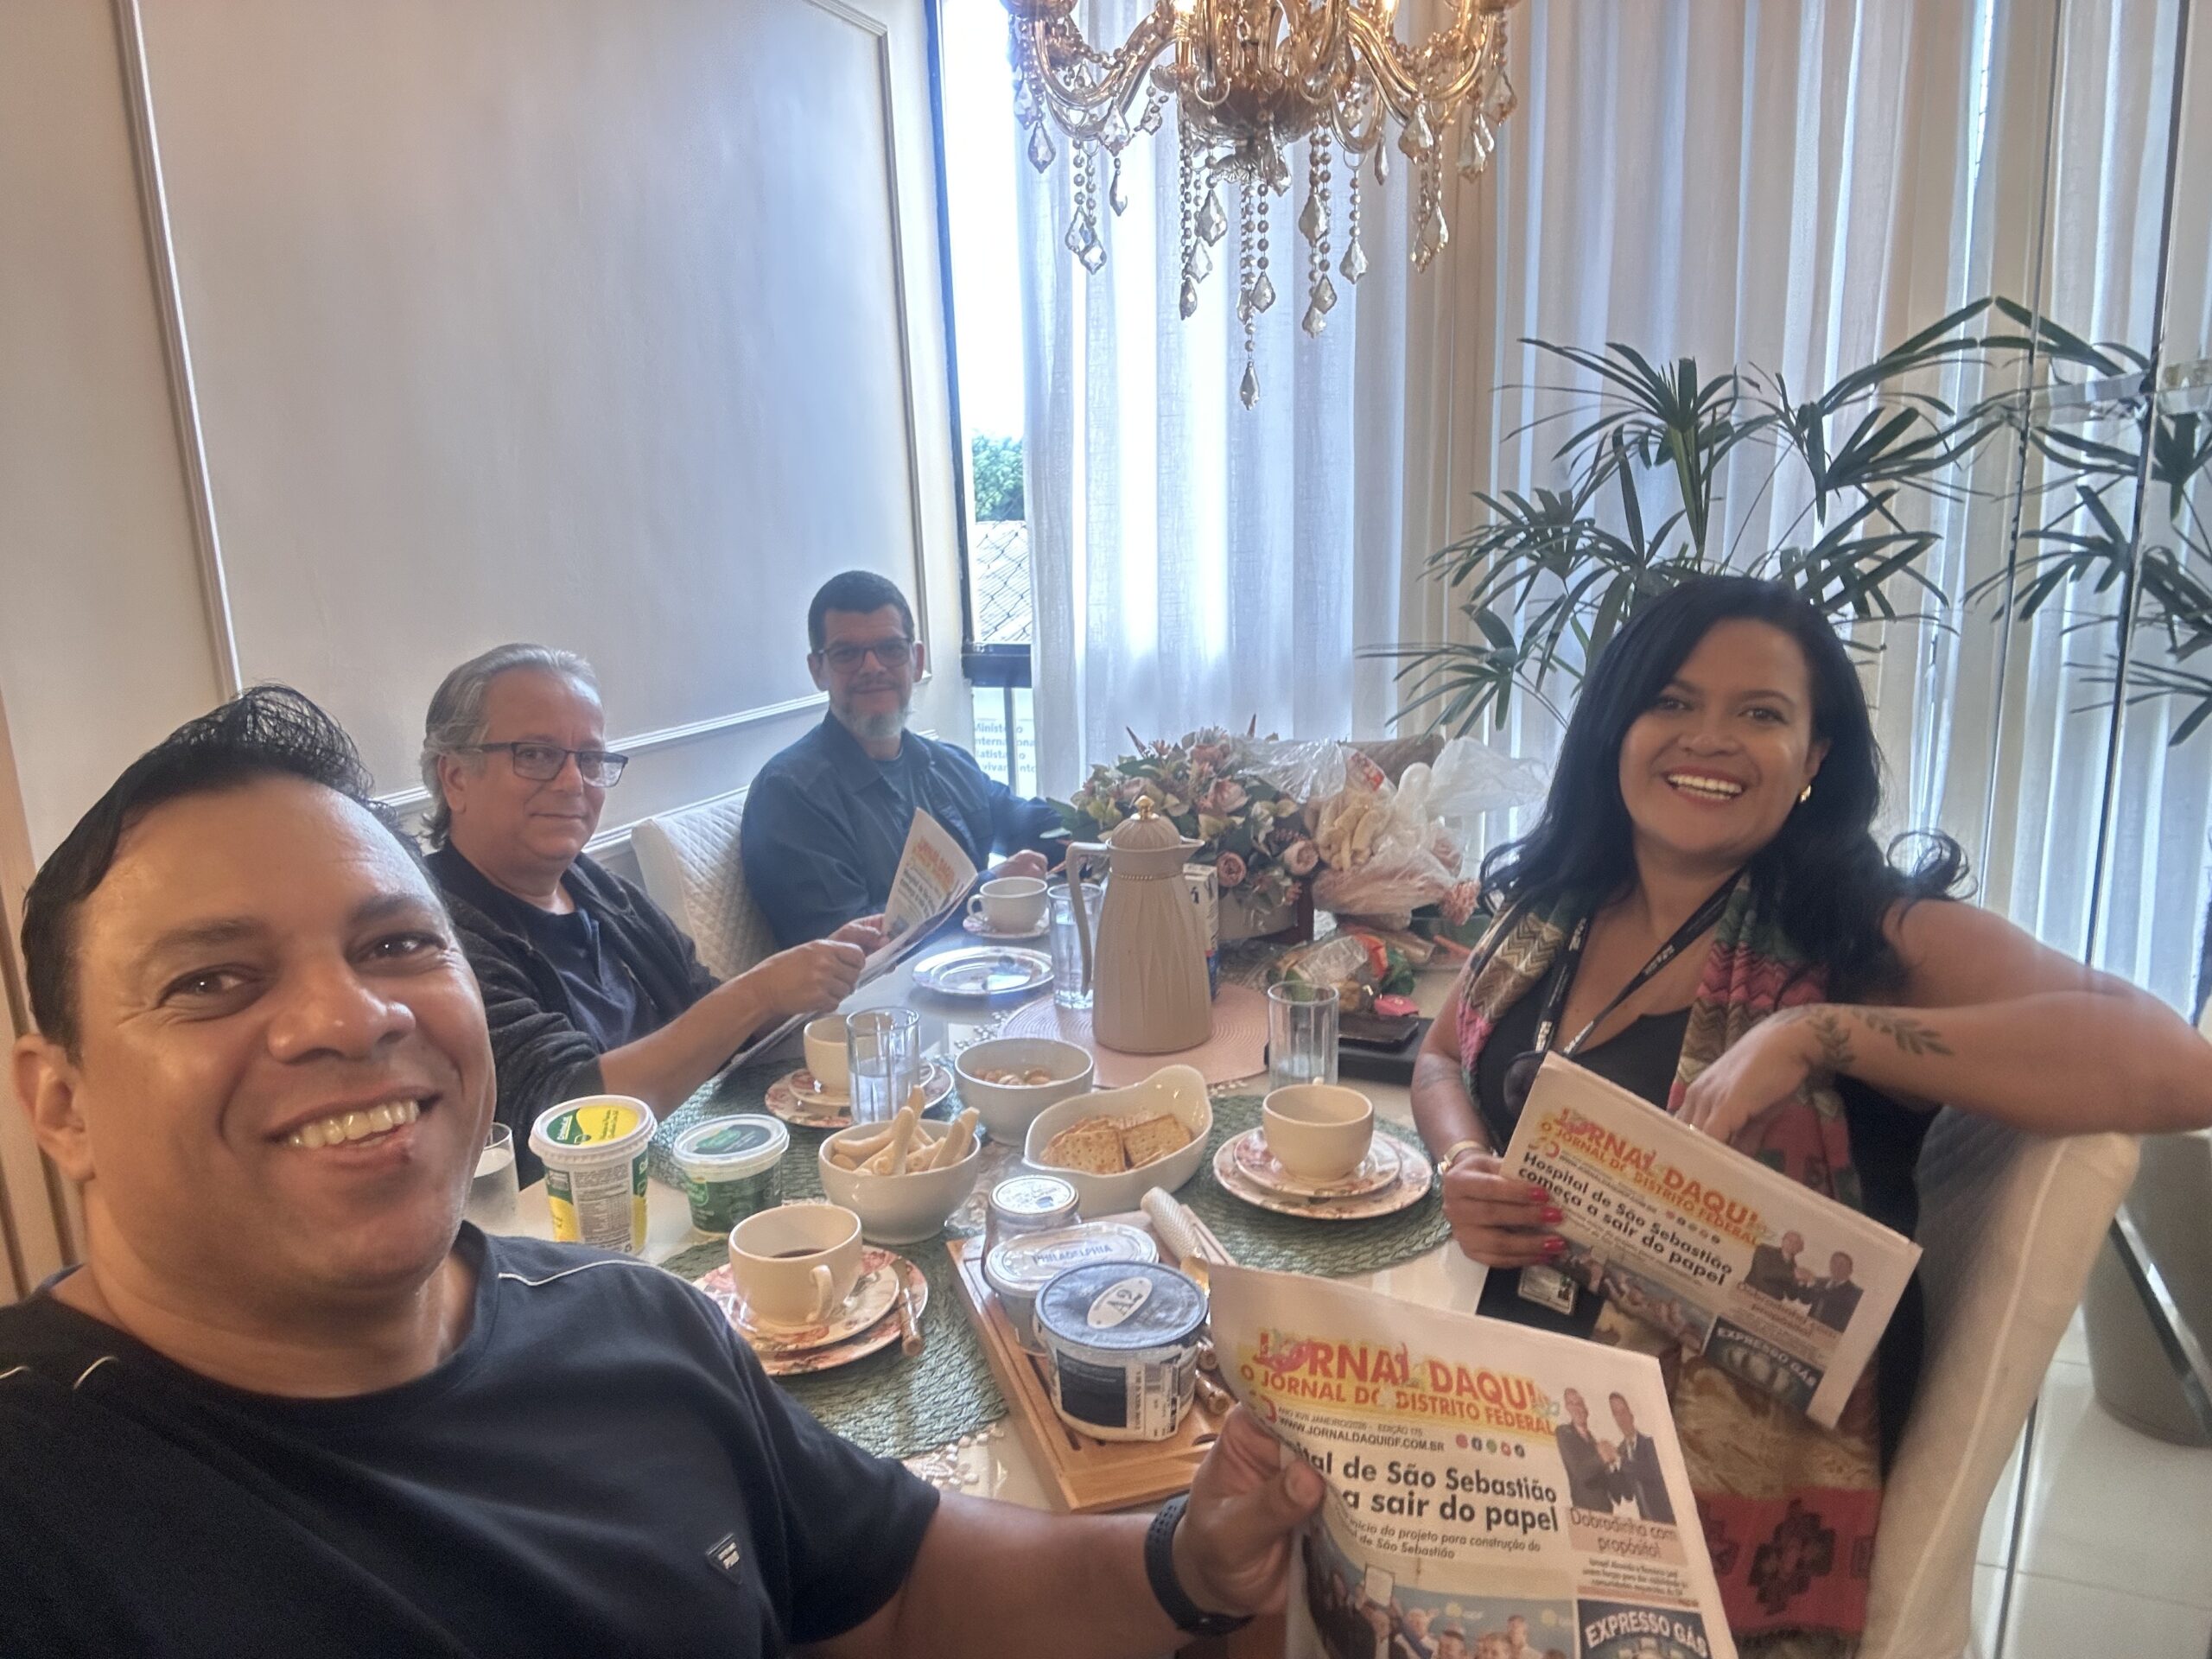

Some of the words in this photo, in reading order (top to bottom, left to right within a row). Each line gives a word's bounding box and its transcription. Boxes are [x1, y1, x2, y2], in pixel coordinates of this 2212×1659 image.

[1541, 1122, 1553, 1132] O
[1555, 1128, 1606, 1163] JORNAL
[1635, 1172, 1694, 1211] DISTRITO
[1699, 1208, 1758, 1247] FEDERAL
[1518, 1168, 1582, 1207] começa
[1587, 1204, 1599, 1217] a
[1603, 1213, 1638, 1237] sair
[1642, 1235, 1664, 1254] do
[1669, 1251, 1726, 1287] papel
[1523, 1152, 1589, 1194] Hospital
[1592, 1191, 1611, 1207] de
[1616, 1202, 1645, 1227] São
[1650, 1222, 1732, 1274] Sebastião
[1033, 1244, 1114, 1265] PHILADELPHIA
[1240, 1363, 1255, 1381] O
[1260, 1370, 1347, 1402] JORNAL
[1395, 1390, 1481, 1421] DISTRITO
[1485, 1405, 1556, 1436] FEDERAL
[1343, 1455, 1377, 1483] de
[1387, 1459, 1436, 1489] São
[1445, 1465, 1558, 1504] Sebastião
[1342, 1489, 1361, 1510] a
[1370, 1490, 1430, 1517] sair
[1439, 1493, 1476, 1523] do
[1485, 1504, 1559, 1535] papel
[1570, 1506, 1648, 1537] Dobradinha
[1359, 1534, 1373, 1547] de
[1376, 1538, 1398, 1552] São
[1401, 1541, 1456, 1560] Sebastião
[1380, 1523, 1396, 1537] do
[1397, 1527, 1439, 1543] projeto
[1440, 1533, 1467, 1547] para
[1469, 1534, 1526, 1553] construção
[1584, 1611, 1671, 1649] EXPRESSO
